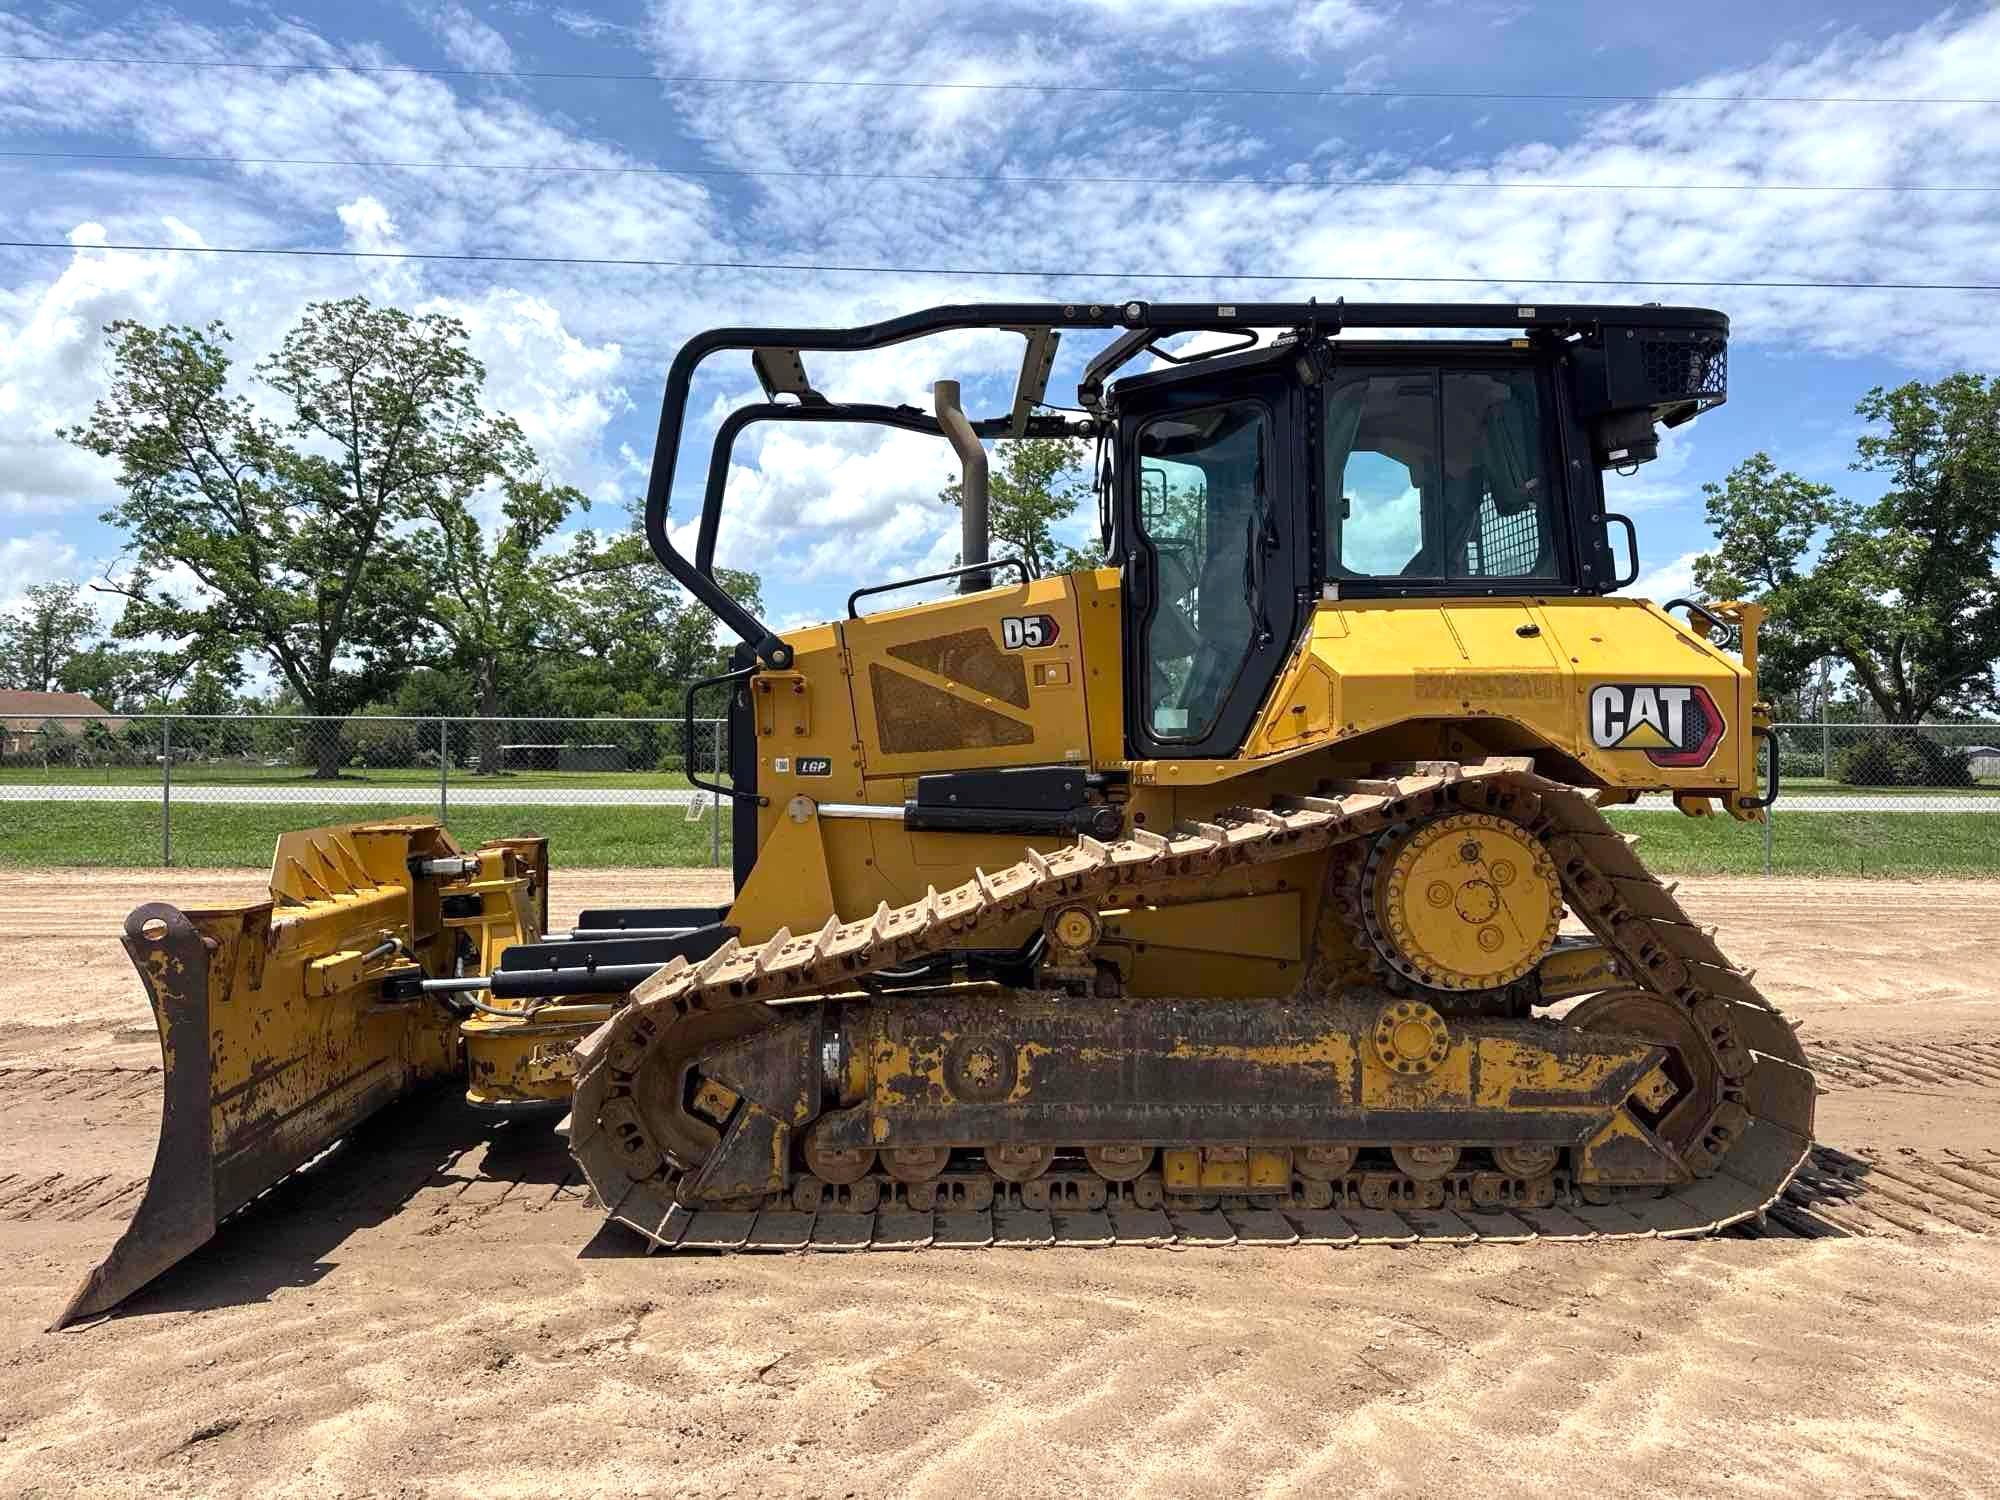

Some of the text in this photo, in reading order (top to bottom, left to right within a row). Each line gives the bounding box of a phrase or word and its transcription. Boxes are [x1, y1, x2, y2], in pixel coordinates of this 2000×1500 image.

[1003, 618, 1042, 648] D5
[1592, 686, 1690, 748] CAT
[802, 761, 826, 772] LGP
